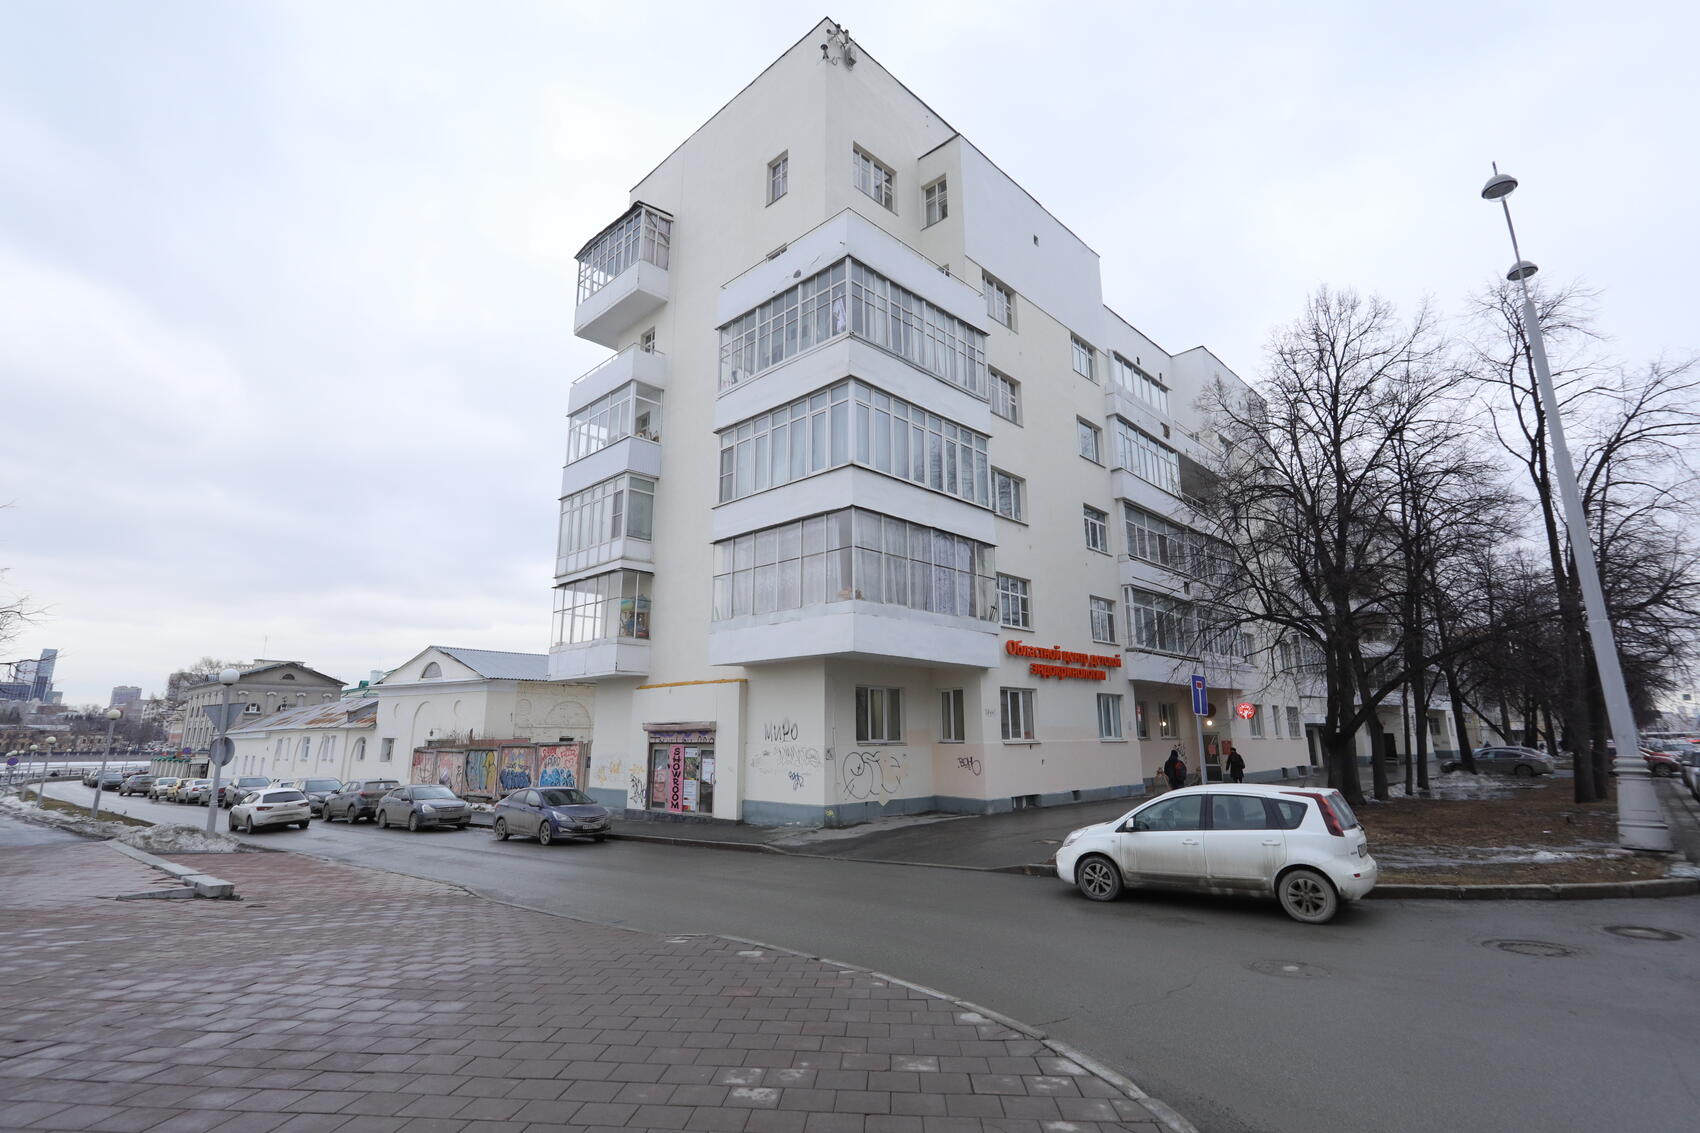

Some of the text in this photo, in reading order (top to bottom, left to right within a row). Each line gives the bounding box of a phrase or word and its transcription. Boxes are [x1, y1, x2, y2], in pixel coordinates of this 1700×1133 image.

[1006, 640, 1061, 660] Областной
[1062, 651, 1089, 666] центр
[671, 747, 681, 809] SHOWROOM
